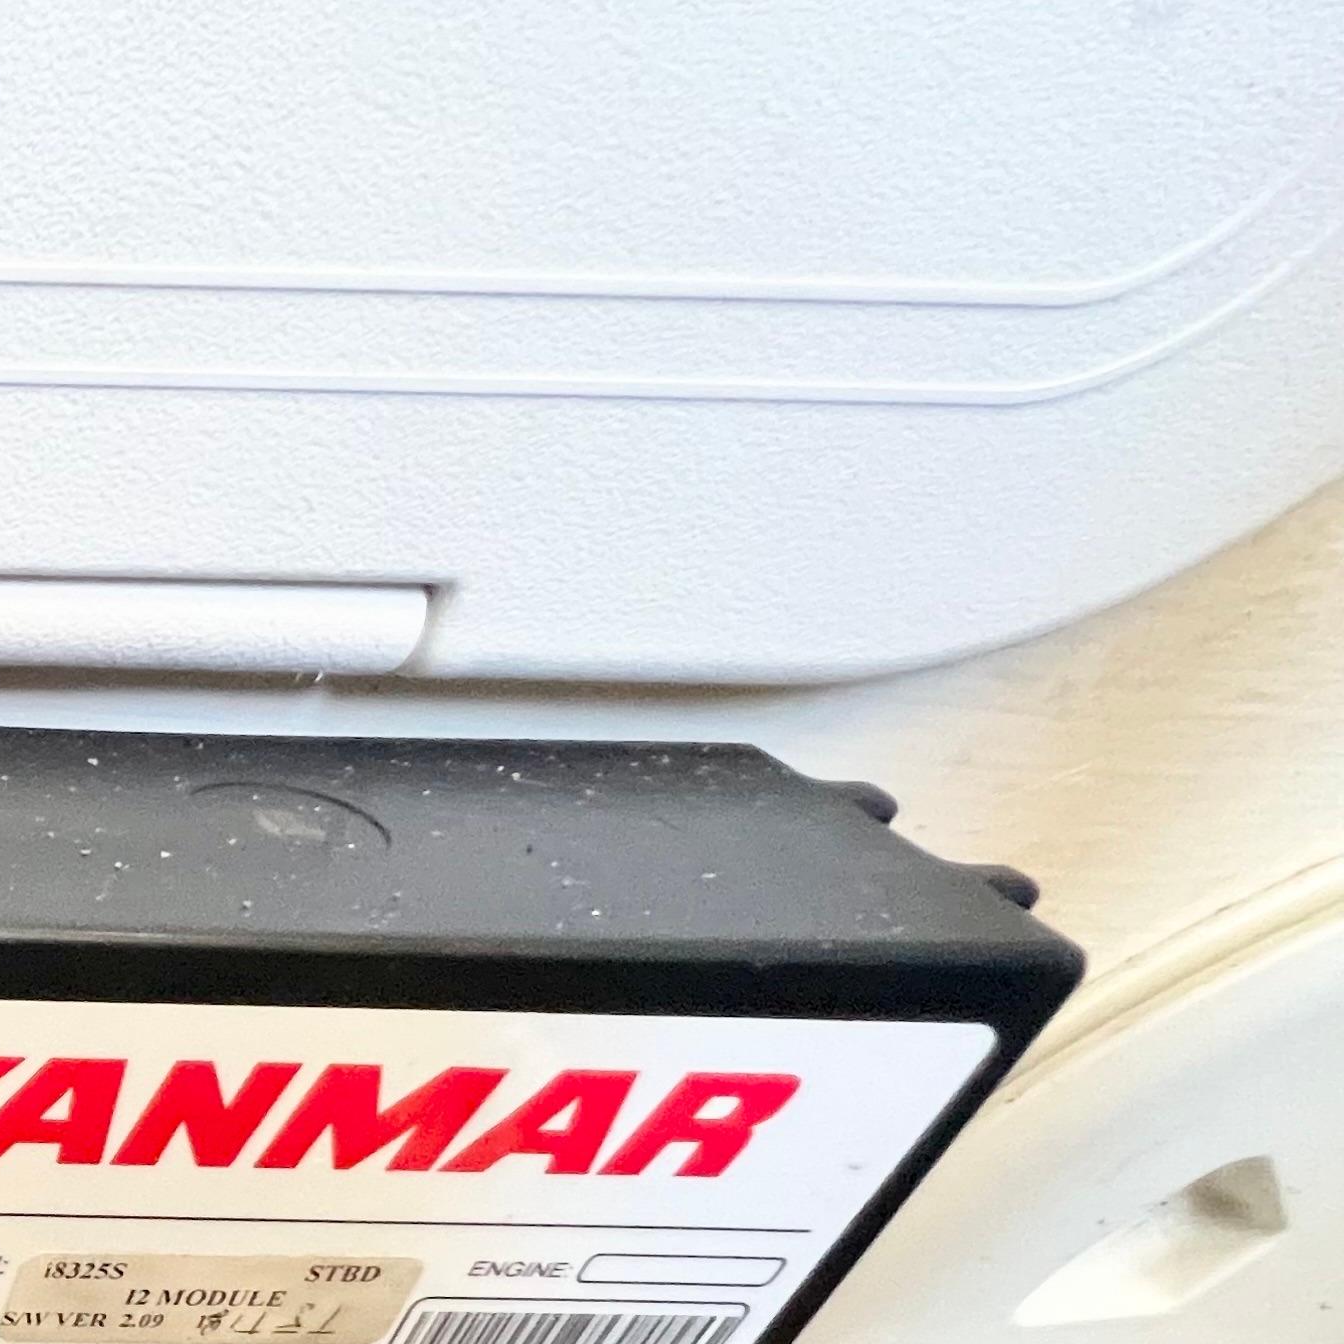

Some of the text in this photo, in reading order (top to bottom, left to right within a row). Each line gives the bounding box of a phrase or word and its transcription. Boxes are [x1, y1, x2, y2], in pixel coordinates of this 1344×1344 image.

[304, 1264, 381, 1283] STBD
[467, 1261, 573, 1278] ENGINE:
[158, 1289, 287, 1307] MODULE
[58, 1311, 107, 1328] VER
[118, 1312, 164, 1329] 2.09
